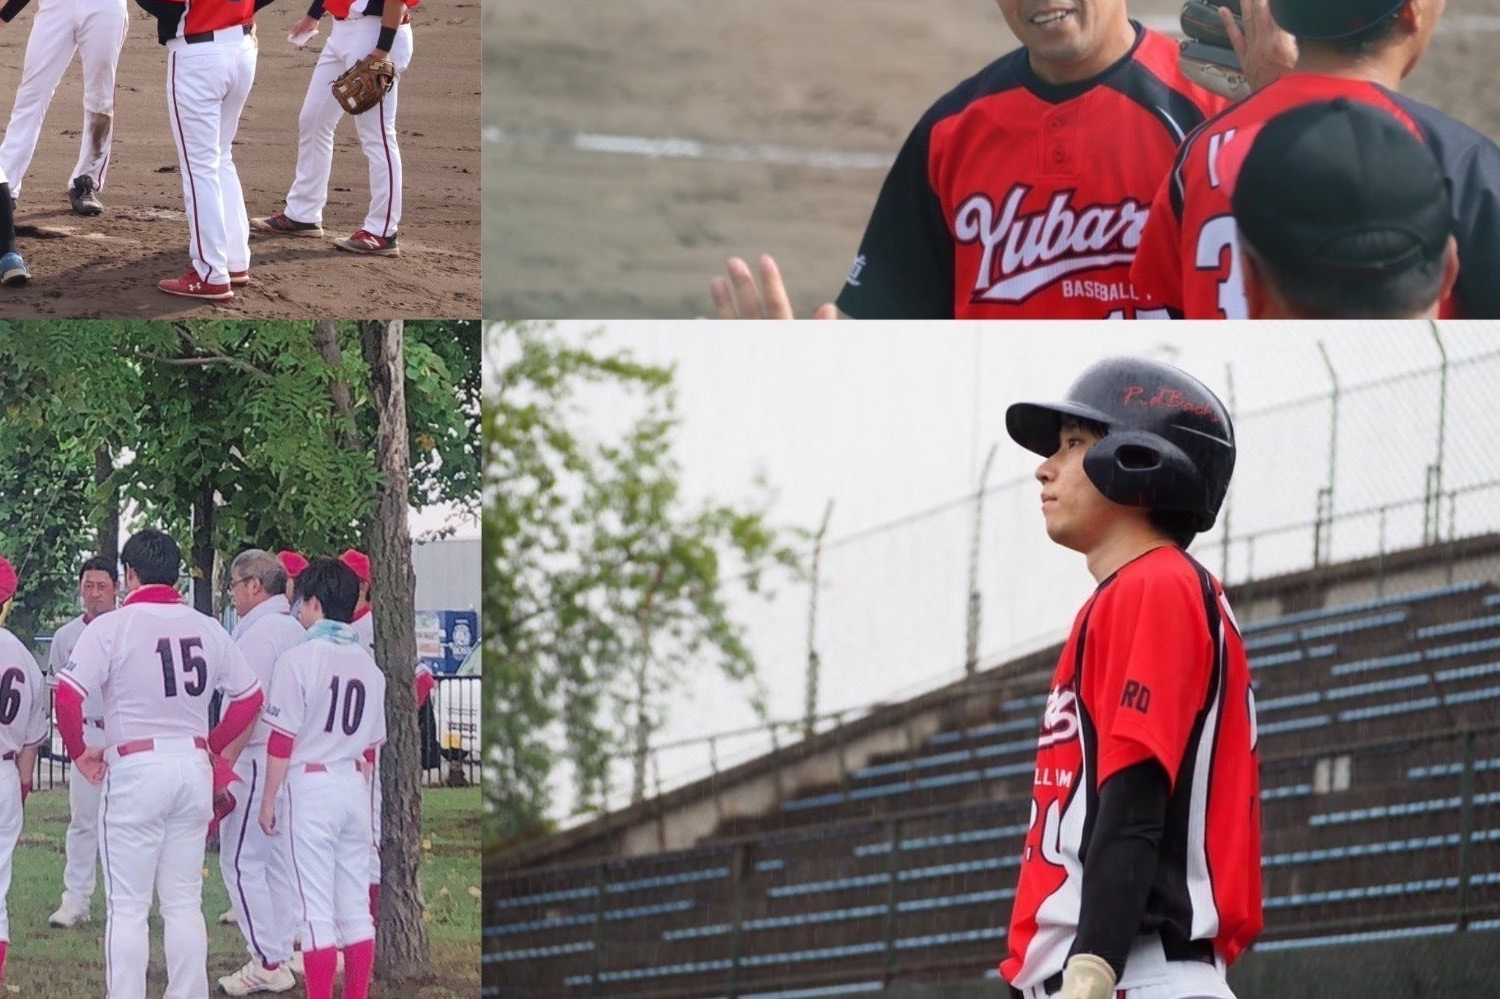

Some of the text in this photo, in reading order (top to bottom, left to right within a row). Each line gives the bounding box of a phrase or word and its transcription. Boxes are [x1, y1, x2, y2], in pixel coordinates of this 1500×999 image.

[1062, 280, 1140, 301] BASEBALL
[155, 637, 207, 697] 15
[325, 676, 366, 736] 10
